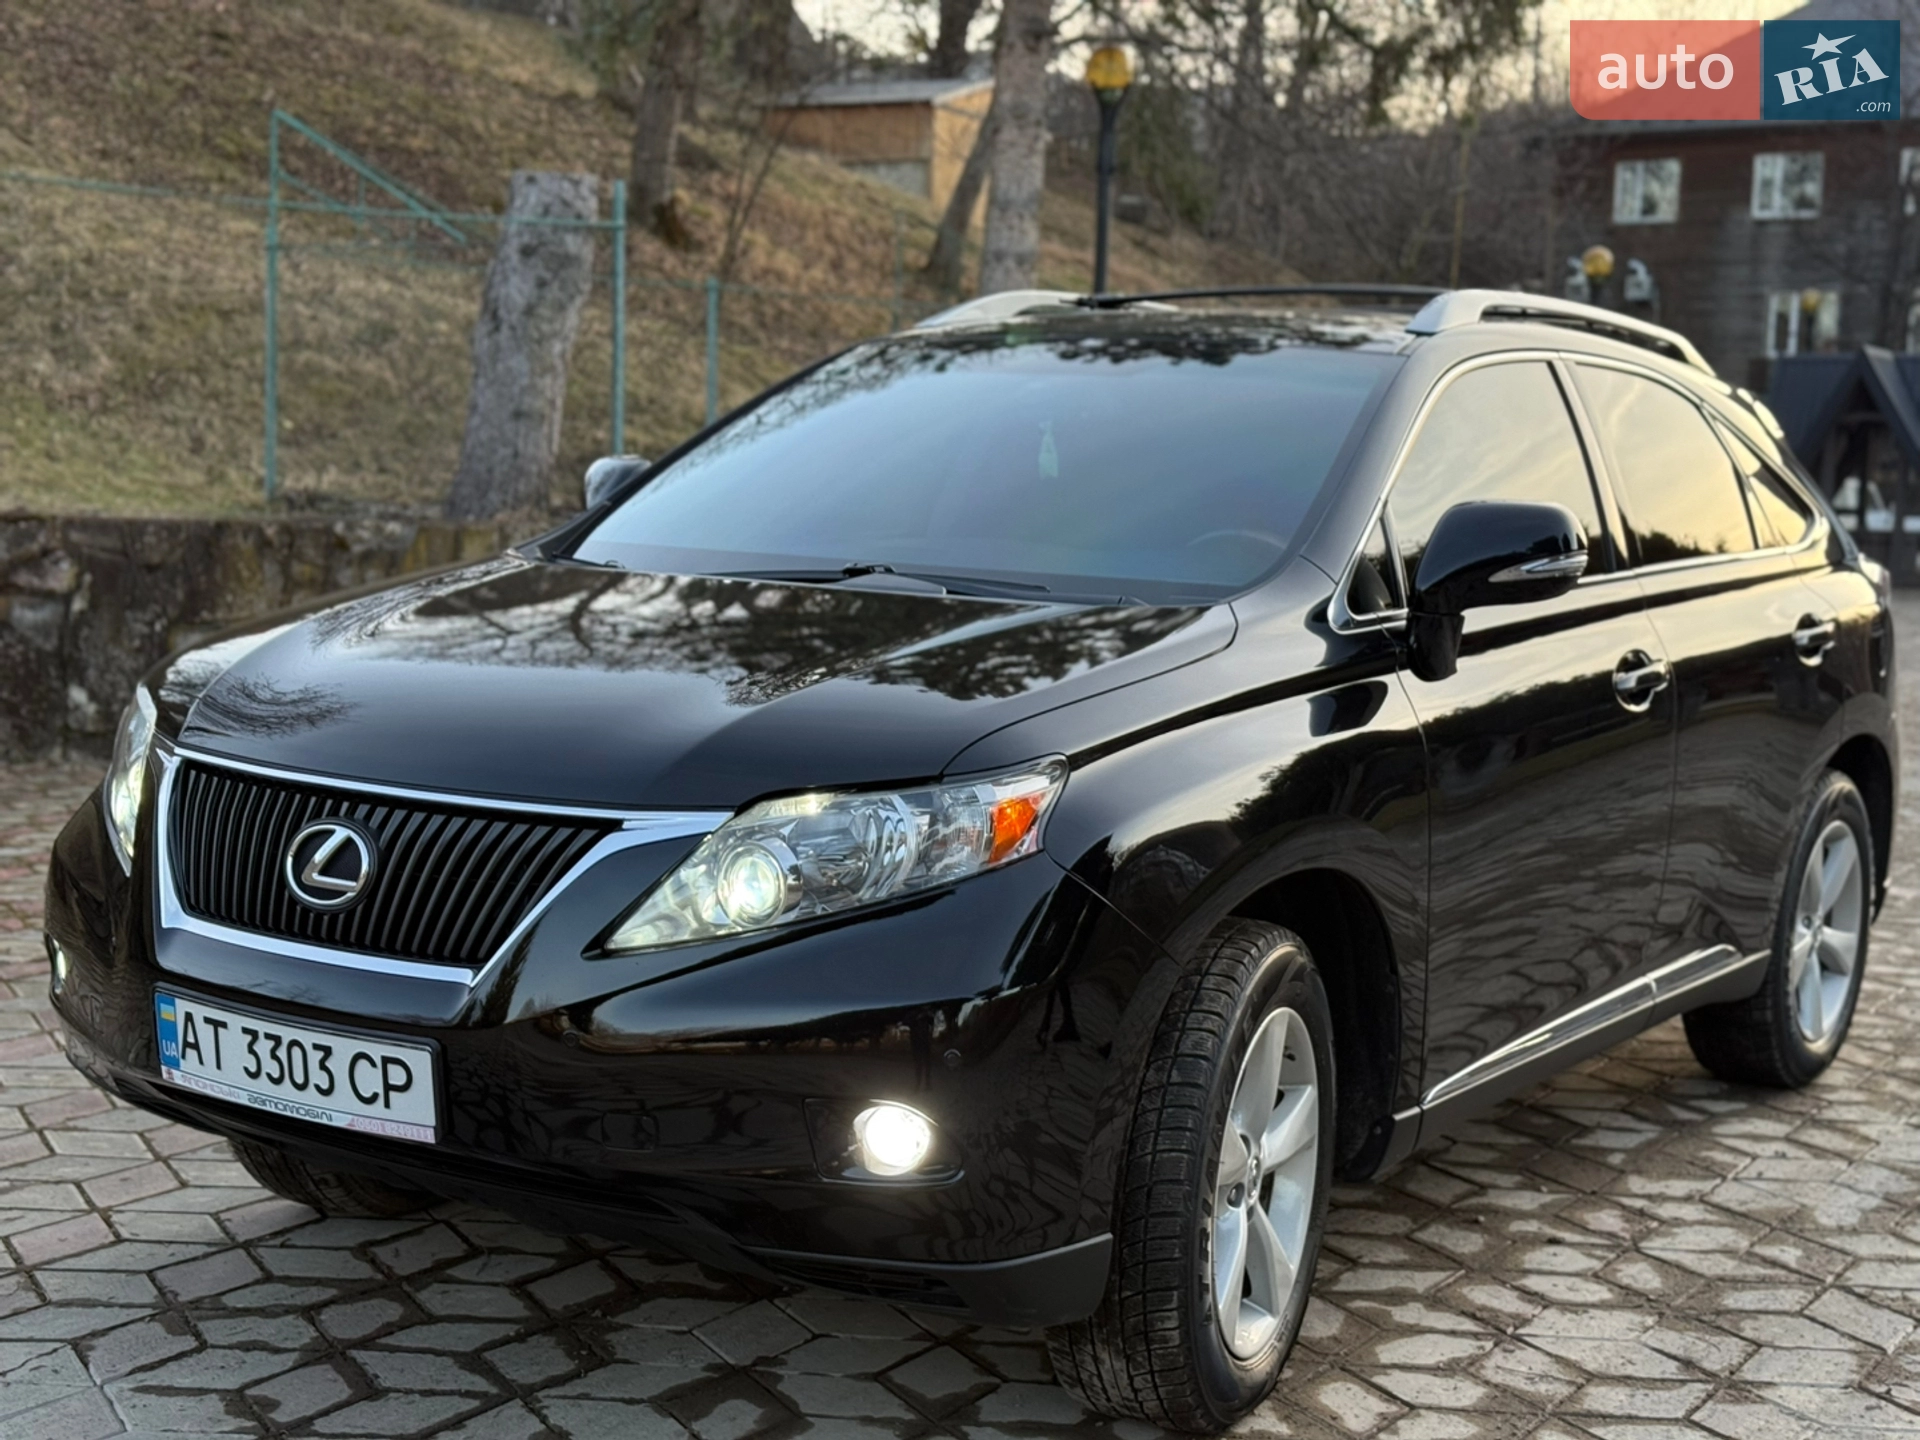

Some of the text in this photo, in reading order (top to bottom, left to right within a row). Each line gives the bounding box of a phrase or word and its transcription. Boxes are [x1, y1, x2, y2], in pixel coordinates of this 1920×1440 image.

[163, 1039, 179, 1059] UA
[181, 1010, 414, 1110] AT 3303 CP
